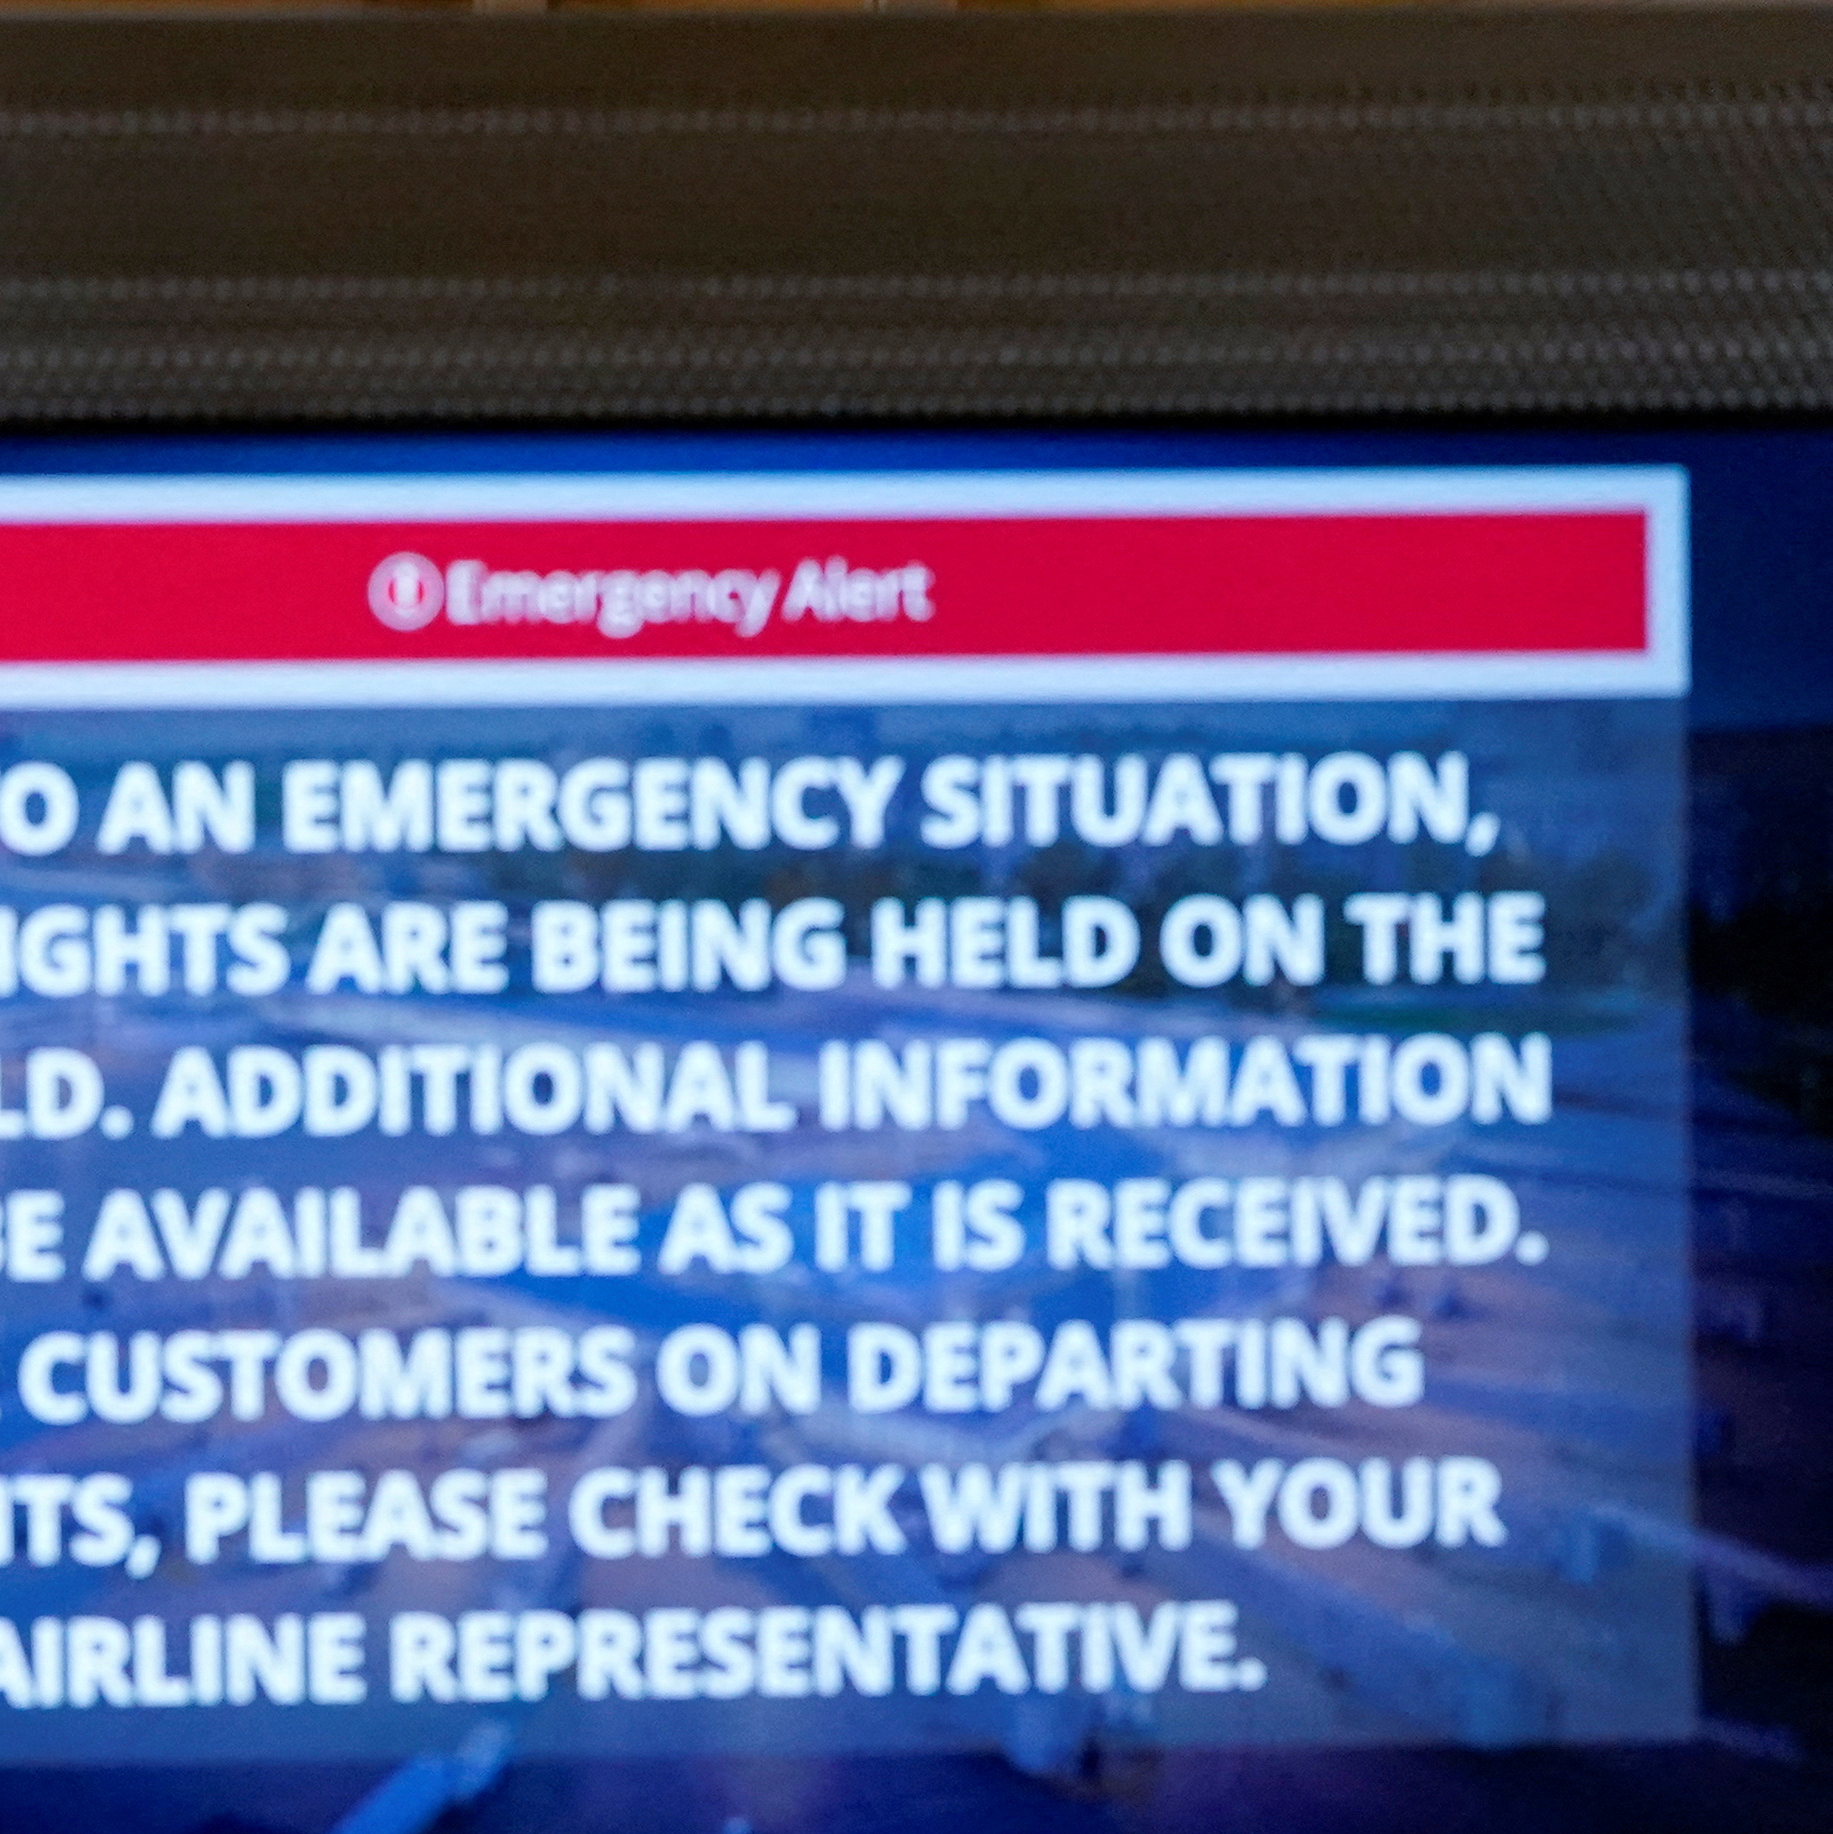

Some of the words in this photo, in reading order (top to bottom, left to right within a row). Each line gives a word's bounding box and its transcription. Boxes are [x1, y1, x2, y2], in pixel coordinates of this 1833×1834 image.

[435, 560, 779, 629] Emergency
[784, 561, 928, 621] Alert
[95, 761, 255, 856] AN
[282, 756, 903, 855] EMERGENCY
[920, 751, 1499, 853] SITUATION,
[305, 900, 508, 996] ARE
[530, 898, 847, 993] BEING
[870, 898, 1139, 993] HELD
[1161, 895, 1323, 986] ON
[1346, 893, 1543, 985] THE
[153, 1039, 796, 1137] ADDITIONAL
[816, 1036, 1549, 1131] INFORMATION
[82, 1181, 641, 1286] AVAILABLE
[657, 1180, 800, 1281] AS
[814, 1177, 911, 1274] IT
[932, 1179, 1025, 1273] IS
[1046, 1173, 1549, 1275] RECEIVED.
[19, 1322, 639, 1424] CUSTOMERS
[656, 1324, 822, 1417] ON
[848, 1314, 1424, 1417] DEPARTING
[184, 1464, 550, 1570] PLEASE
[567, 1462, 905, 1561] CHECK
[919, 1459, 1193, 1554] WITH
[1211, 1455, 1505, 1552] YOUR
[388, 1599, 1267, 1703] REPRESENTATIVE.
